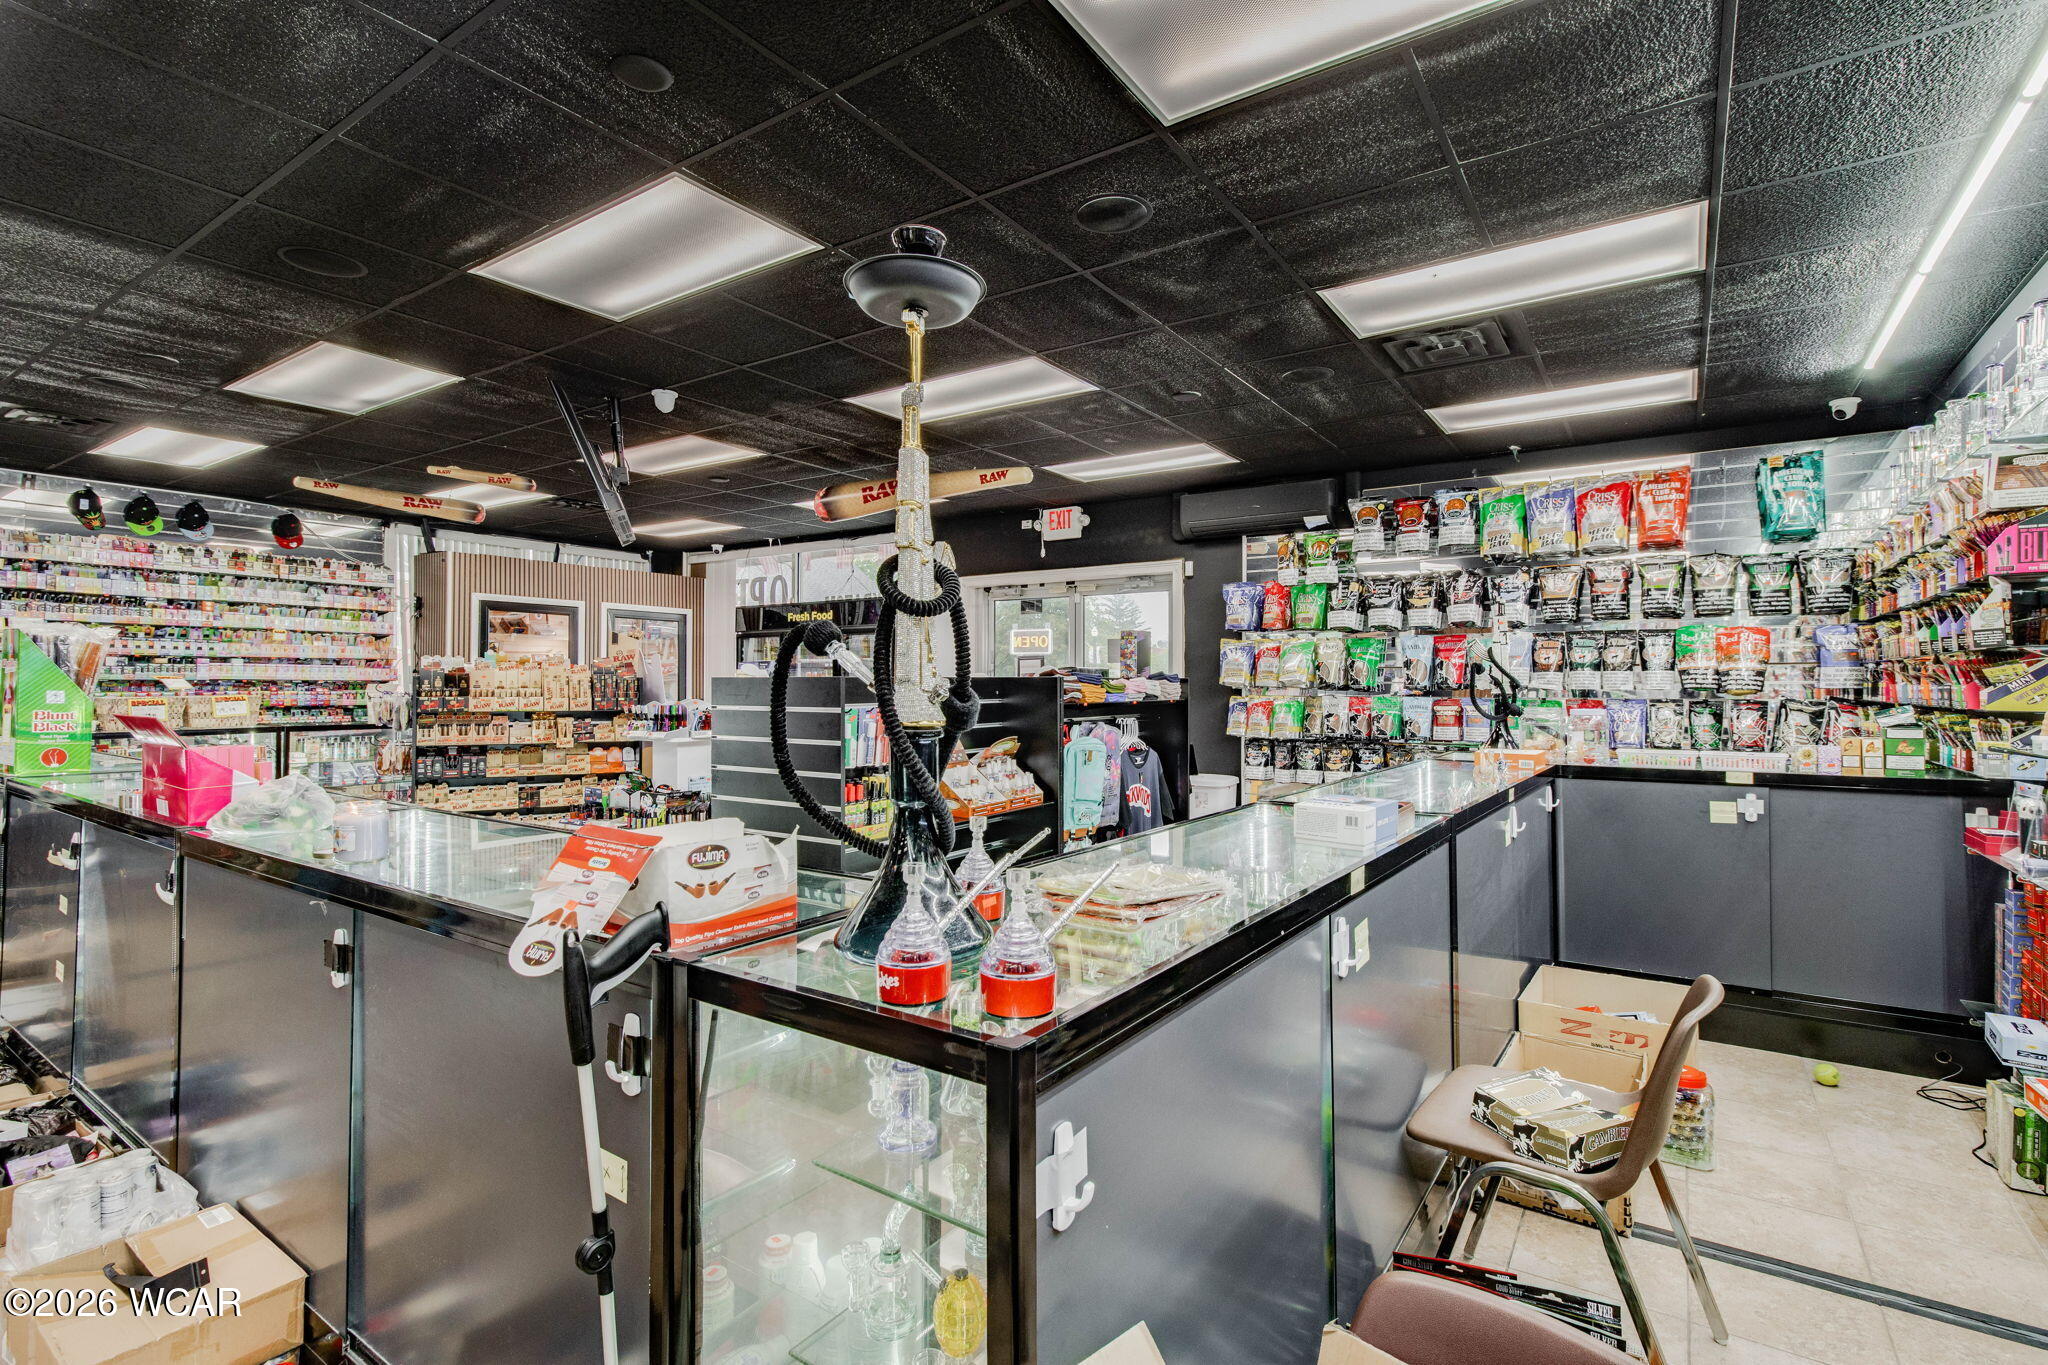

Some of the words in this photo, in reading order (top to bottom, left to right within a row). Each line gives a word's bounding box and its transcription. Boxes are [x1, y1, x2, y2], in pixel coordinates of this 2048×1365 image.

[488, 475, 512, 485] RAW
[979, 469, 1009, 485] RAW
[312, 480, 339, 489] RAW
[403, 496, 443, 509] RAW
[1049, 509, 1072, 531] EXIT
[787, 611, 810, 622] Fresh
[811, 610, 833, 621] Food
[1720, 635, 1739, 643] Red
[613, 653, 635, 663] RAW
[2007, 673, 2035, 691] MINI
[473, 702, 491, 710] RAW
[523, 700, 540, 708] RAW
[33, 710, 76, 721] Blunt
[33, 721, 76, 732] Black
[691, 849, 726, 863] FUJIMA
[685, 933, 704, 943] Quality
[715, 927, 734, 935] Cleaner
[733, 923, 746, 931] Extra
[746, 918, 769, 928] Absorbent
[769, 913, 784, 922] Cotton
[525, 945, 553, 962] FUJIMA
[1586, 1301, 1613, 1319] SILVER
